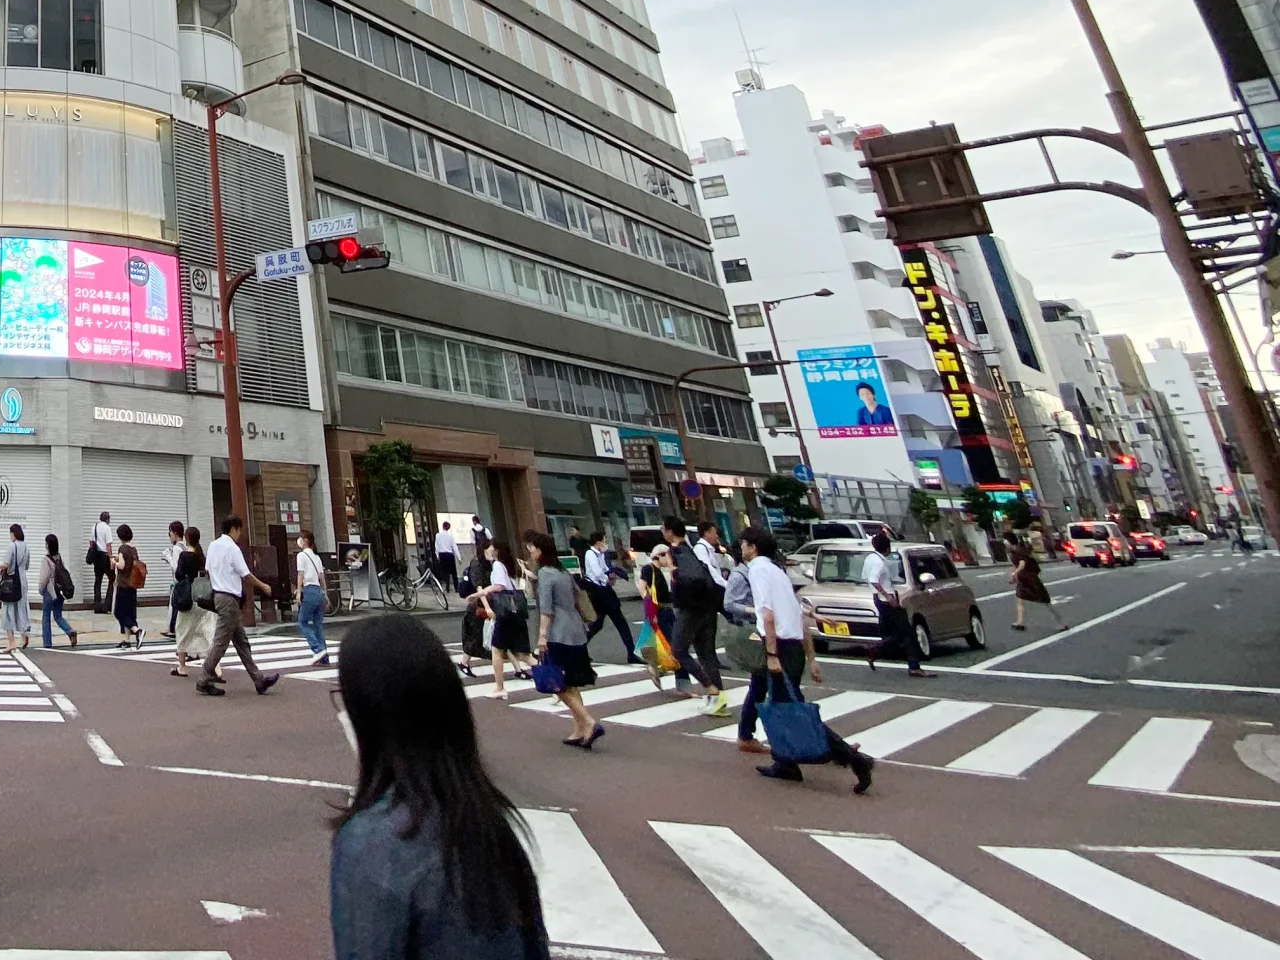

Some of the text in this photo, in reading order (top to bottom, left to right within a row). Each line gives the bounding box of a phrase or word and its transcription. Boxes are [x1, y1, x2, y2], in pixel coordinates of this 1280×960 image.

[5, 103, 82, 121] LUYS
[312, 218, 354, 234] スクランブル式
[265, 251, 300, 267] 呉服町
[263, 264, 304, 277] Gofuku-cho
[74, 288, 129, 302] 2024年4月
[75, 304, 90, 313] JR
[904, 262, 970, 418] ドン・キホーテ
[94, 406, 183, 428] EXELCO DIAMOND
[262, 430, 285, 441] NINE
